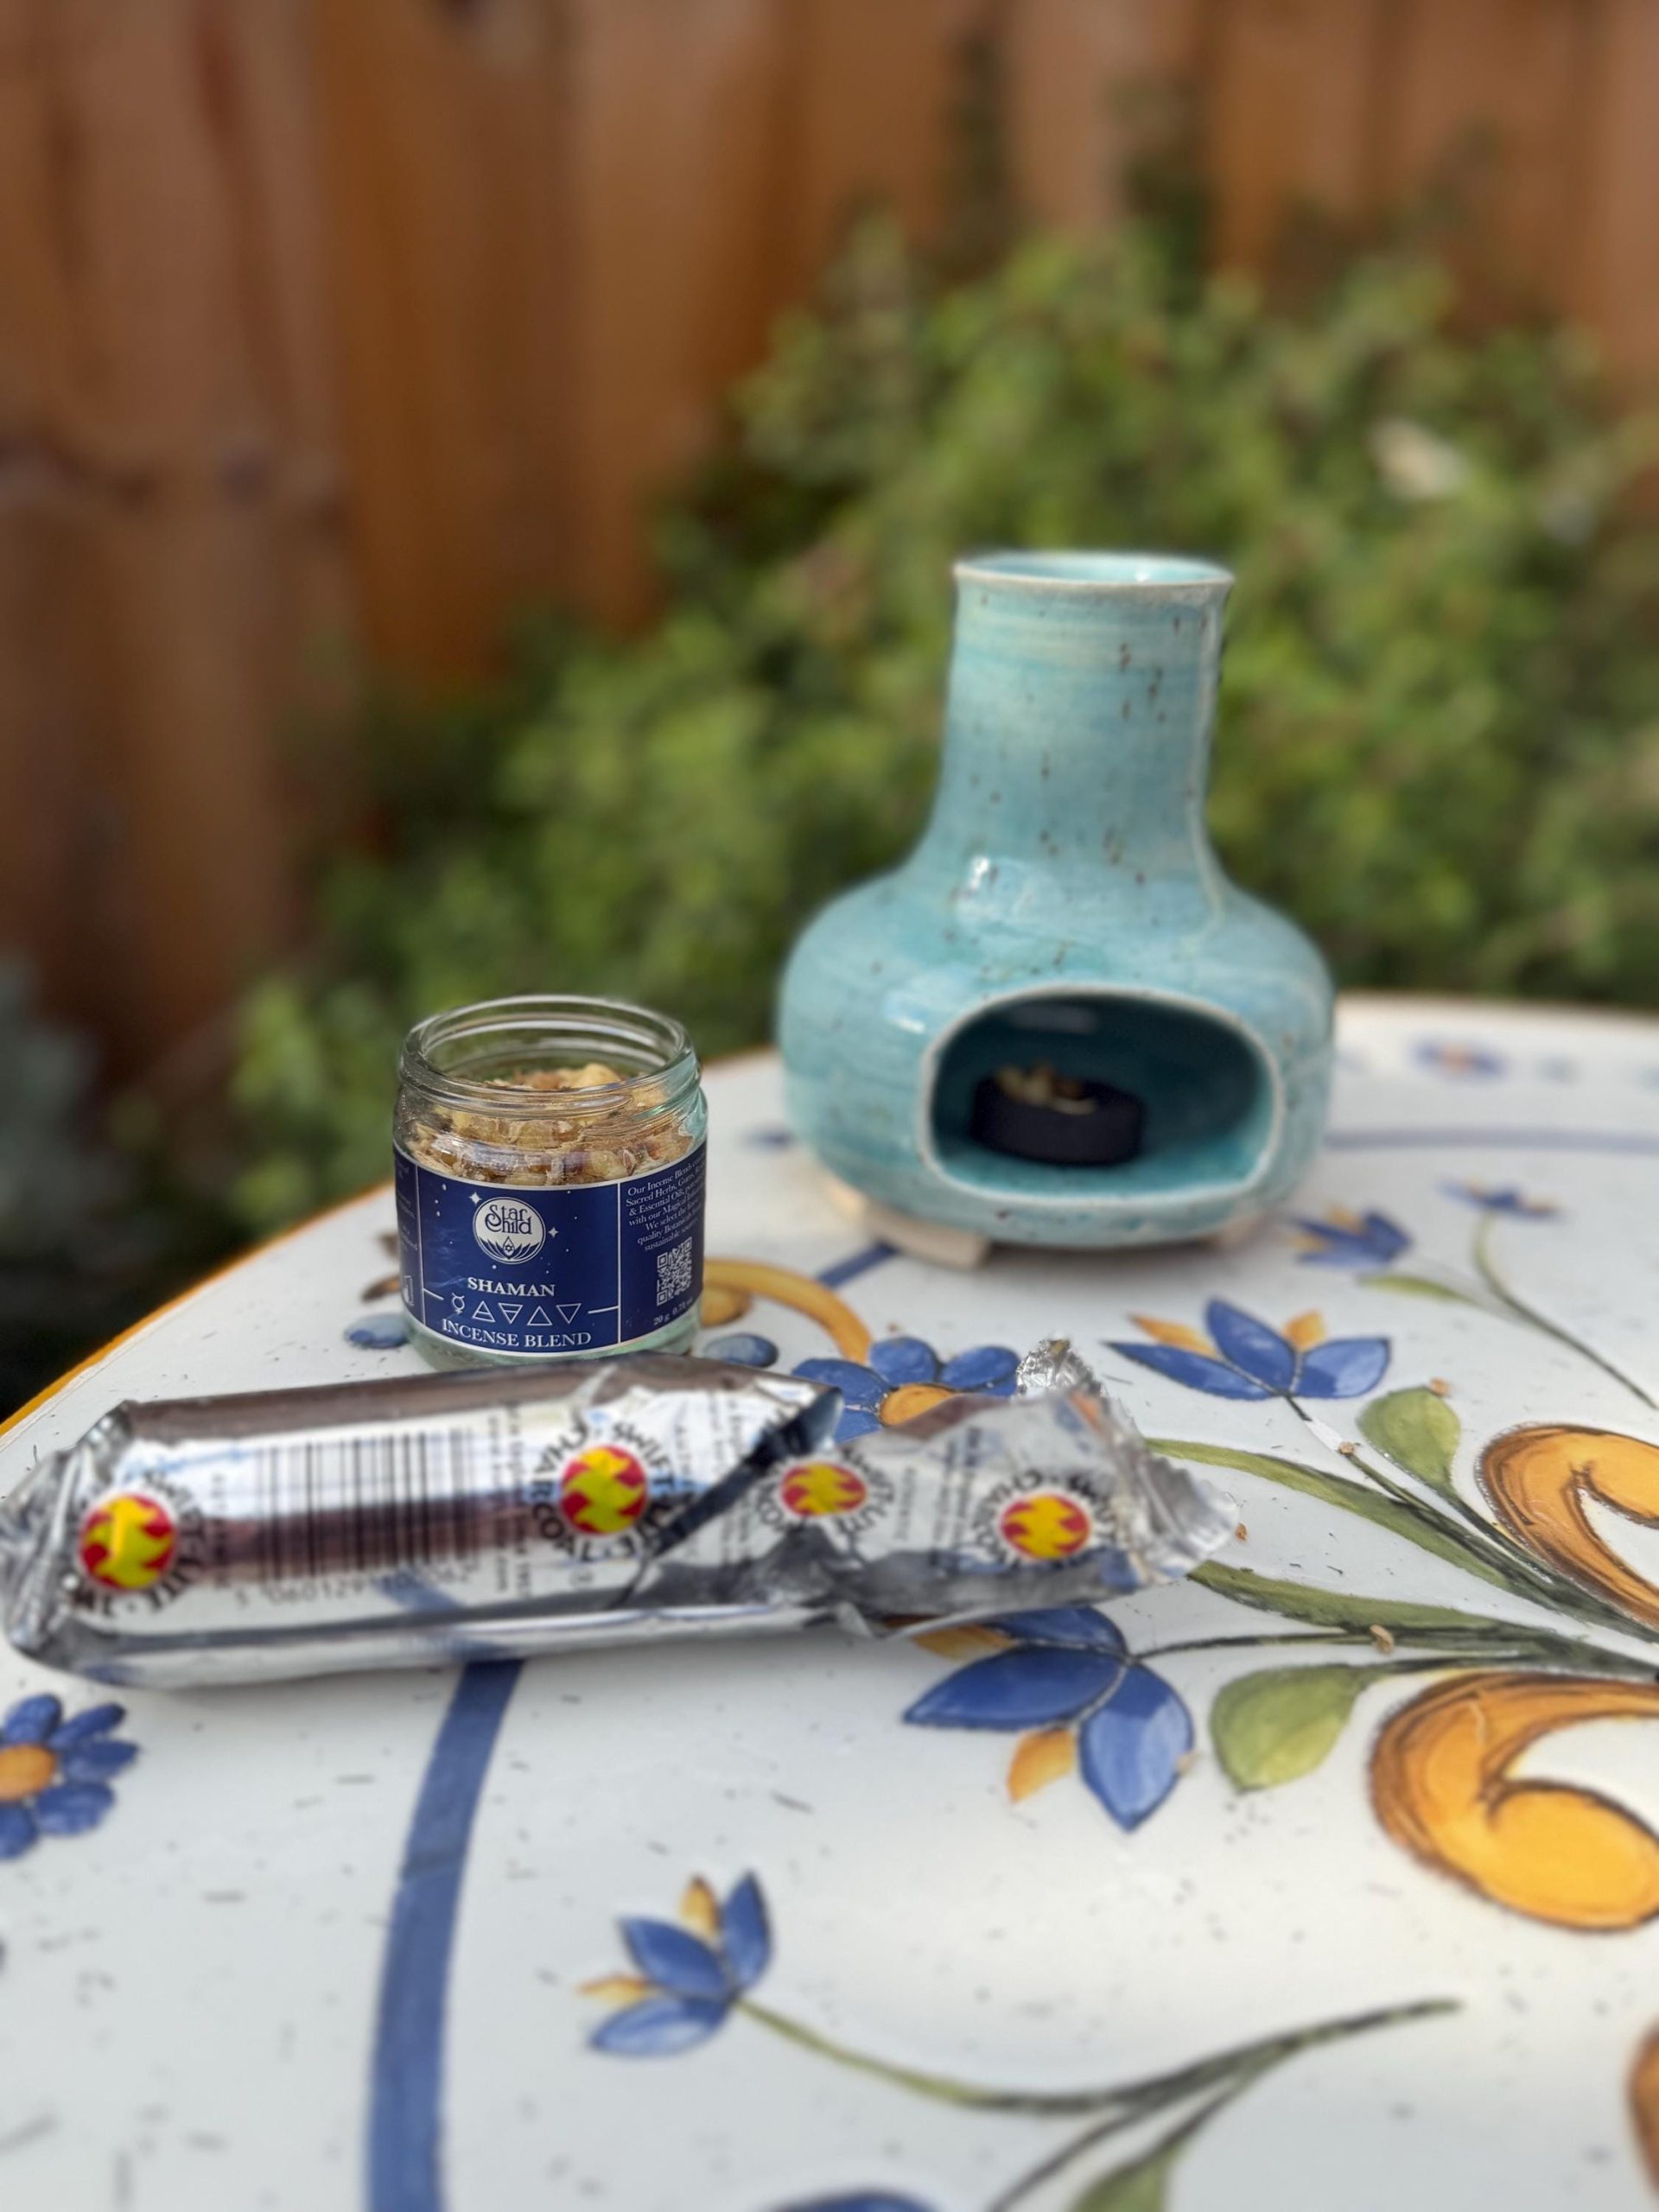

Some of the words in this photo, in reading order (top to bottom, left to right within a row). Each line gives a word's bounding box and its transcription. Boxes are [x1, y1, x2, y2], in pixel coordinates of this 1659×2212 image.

[628, 1186, 646, 1196] Our
[647, 1175, 674, 1191] Incense
[626, 1192, 653, 1207] Sacred
[629, 1208, 637, 1217] &
[639, 1195, 671, 1213] Essential
[485, 1213, 533, 1234] Child
[486, 1205, 528, 1226] Star
[629, 1215, 646, 1226] with
[648, 1211, 661, 1220] our
[645, 1222, 659, 1230] We
[660, 1214, 677, 1225] select
[637, 1229, 663, 1246] quality
[644, 1230, 680, 1251] sustainable
[467, 1276, 556, 1296] SHAMAN
[442, 1319, 519, 1346] INCENSE
[524, 1332, 592, 1348] BLEND
[613, 1421, 675, 1490] SWIFT
